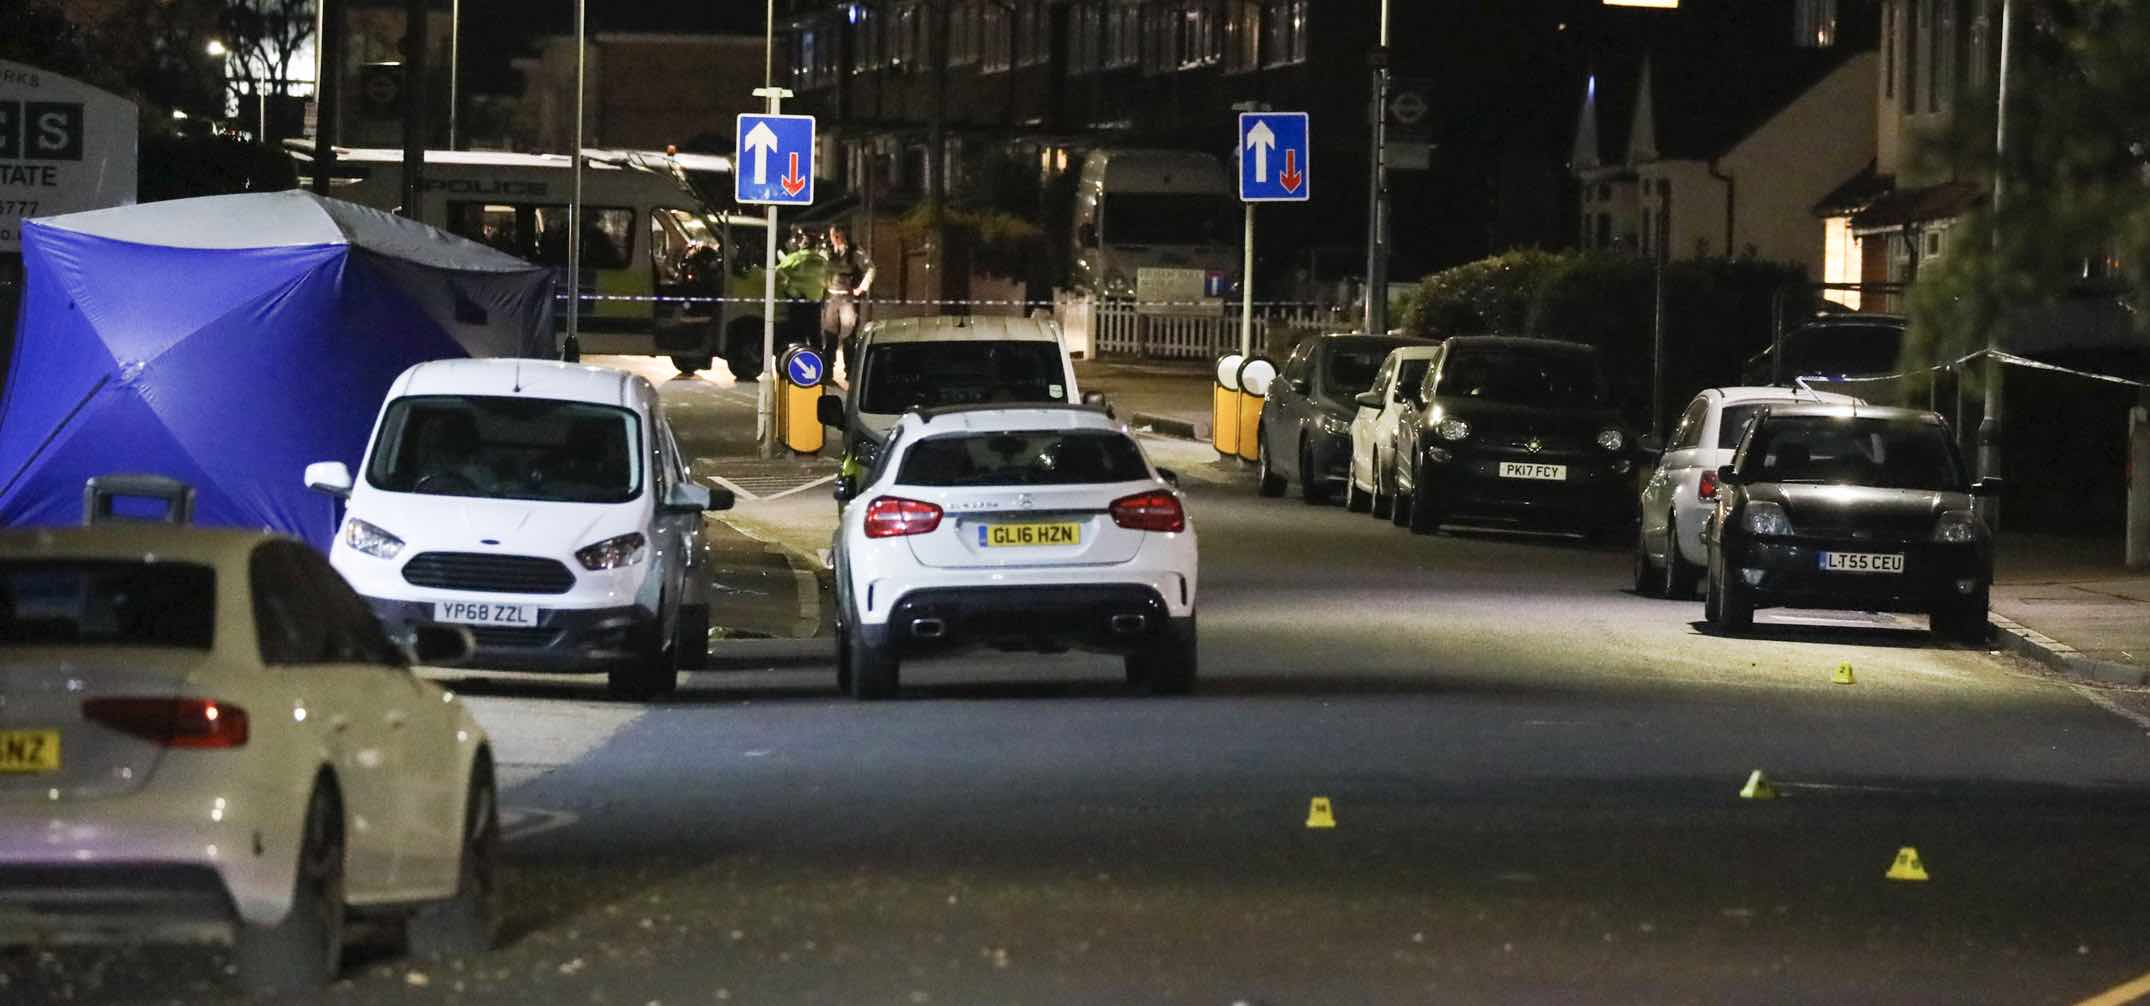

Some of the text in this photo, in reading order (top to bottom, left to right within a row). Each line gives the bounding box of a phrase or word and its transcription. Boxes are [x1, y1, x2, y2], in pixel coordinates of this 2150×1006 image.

[426, 179, 547, 195] POLICE
[1507, 464, 1559, 478] PK17 FCY
[993, 526, 1072, 544] GL16 HZN
[1828, 553, 1901, 570] LT55 CEU
[444, 602, 528, 623] YP68 ZZL
[0, 736, 45, 765] NZ
